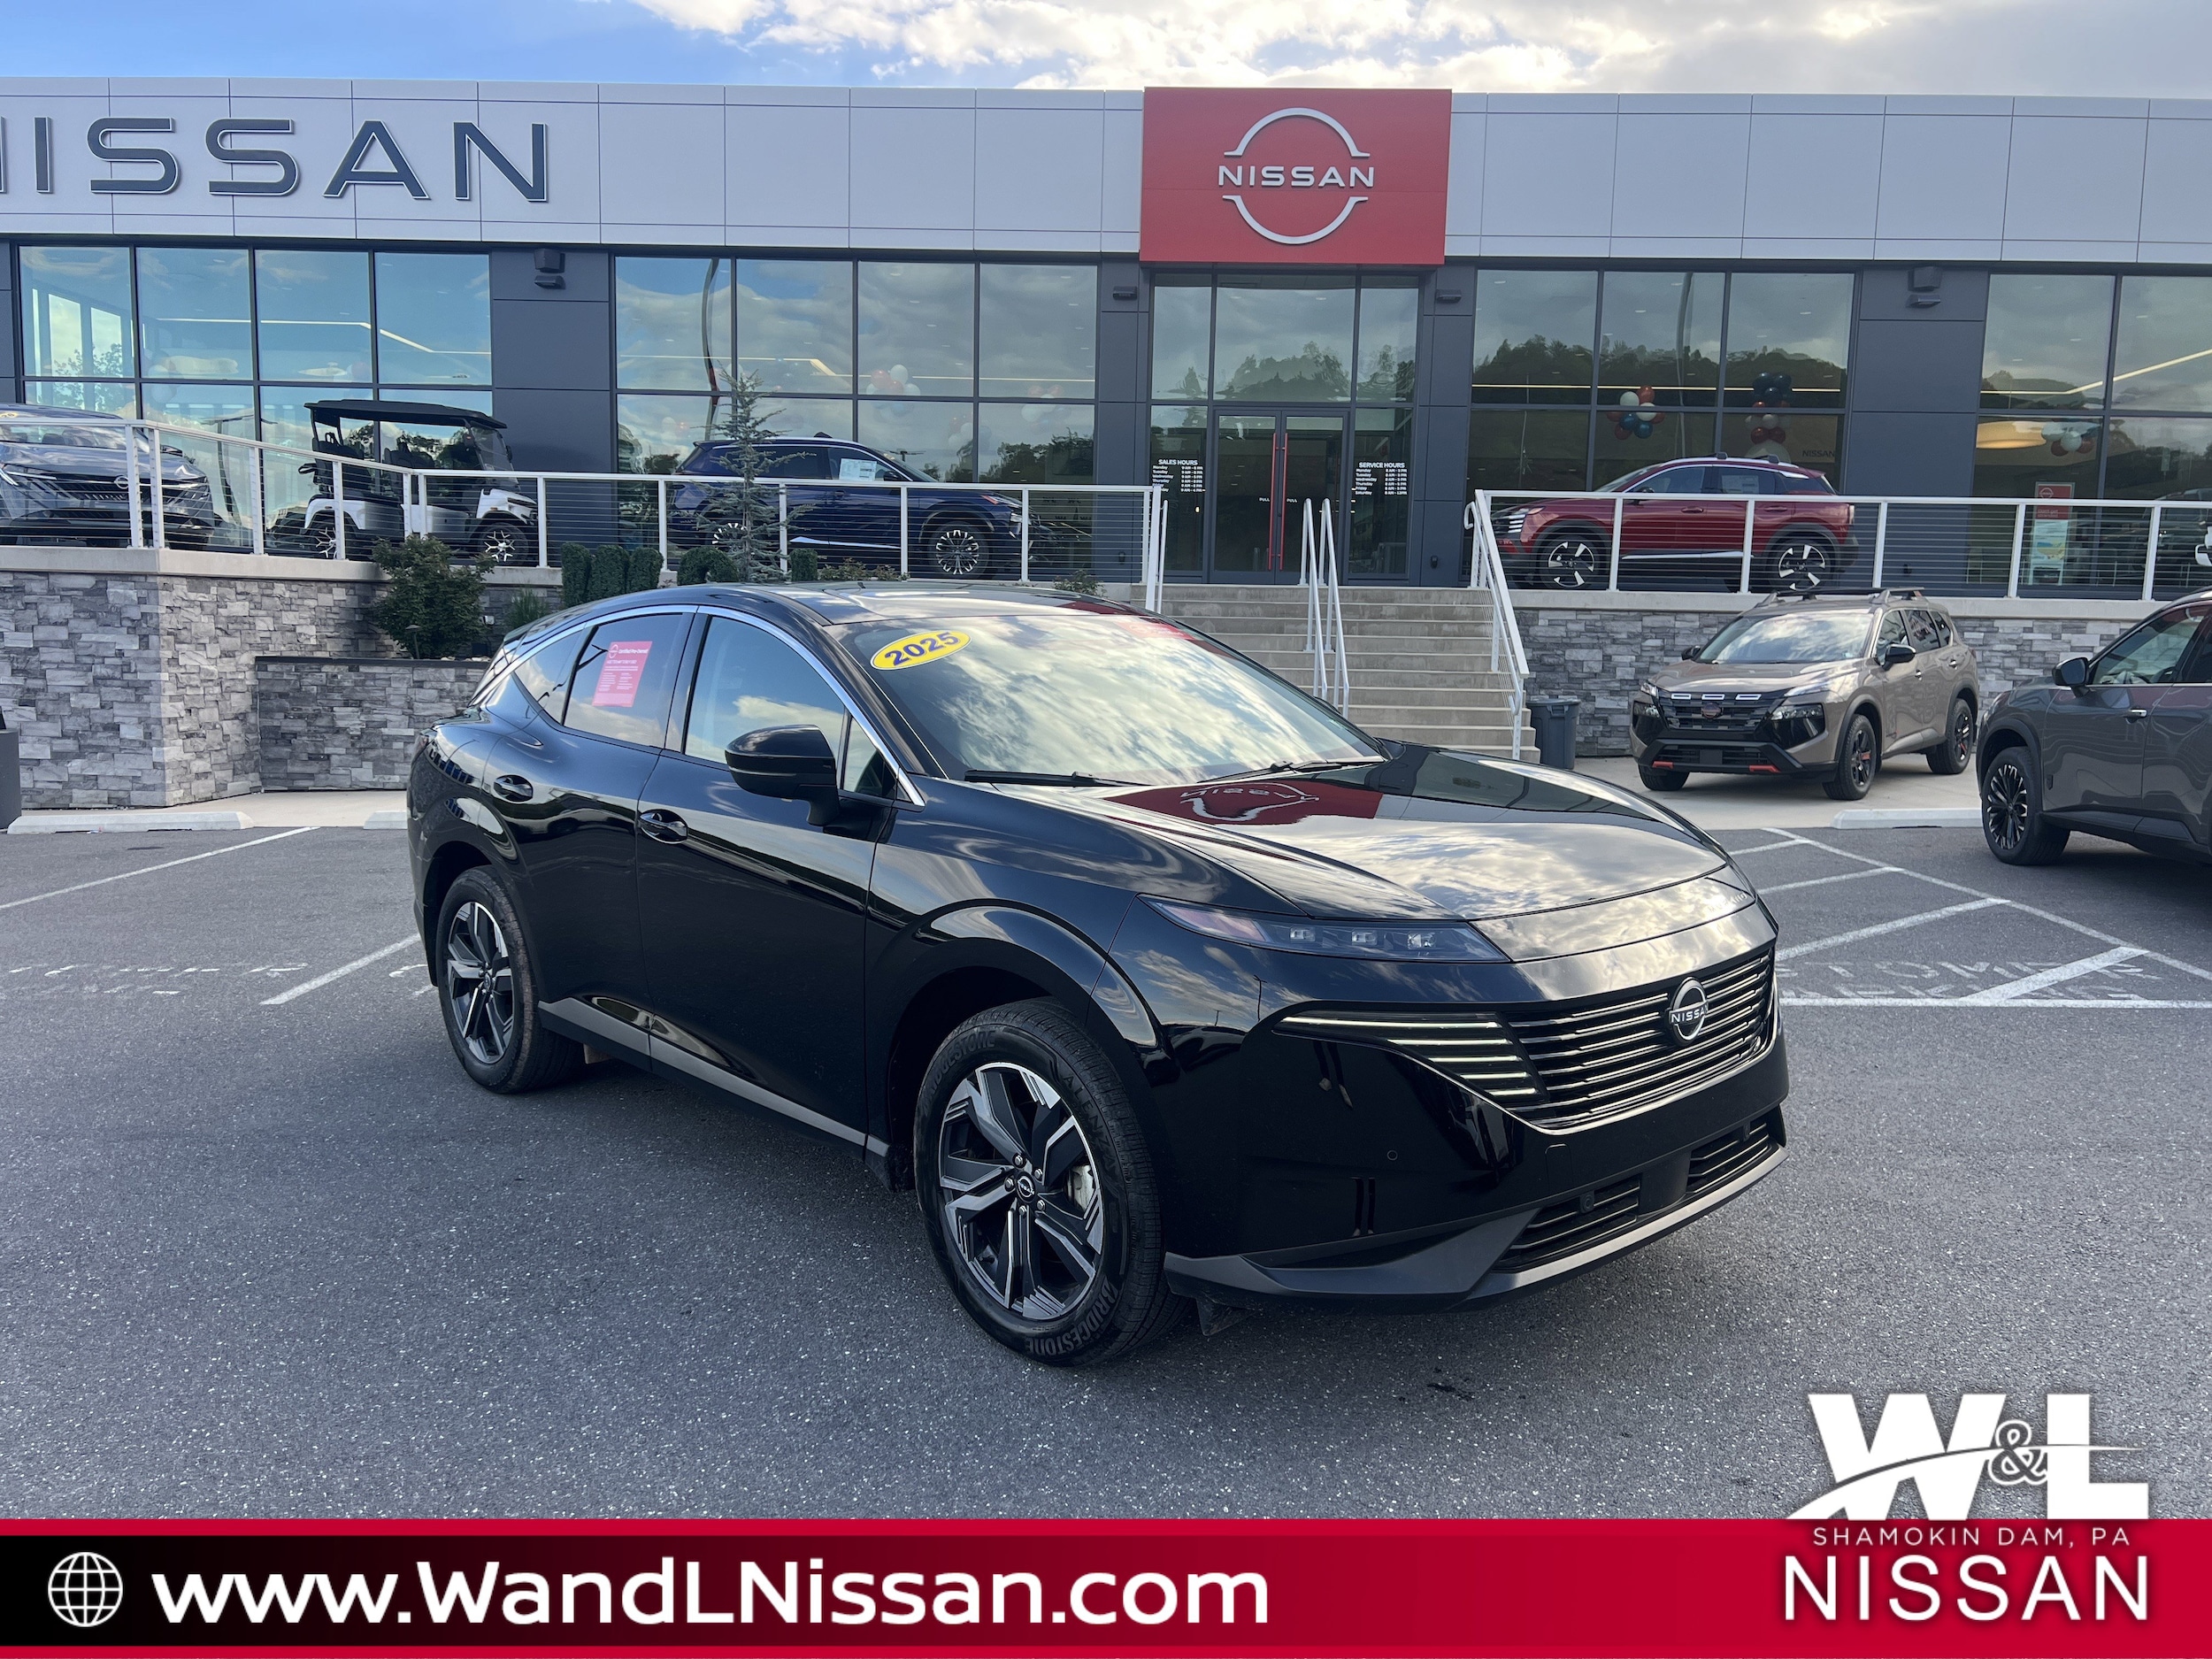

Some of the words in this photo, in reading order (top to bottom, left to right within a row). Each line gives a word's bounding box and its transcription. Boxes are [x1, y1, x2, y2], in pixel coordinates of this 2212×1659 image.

[0, 115, 549, 202] ISSAN
[1217, 165, 1375, 188] NISSAN
[1801, 449, 1836, 458] NISSAN
[885, 632, 959, 665] 2025
[1671, 1003, 1709, 1025] NISSAN
[1062, 1073, 1118, 1173] ALENZA
[1025, 1274, 1120, 1356] BRIDGESTONE
